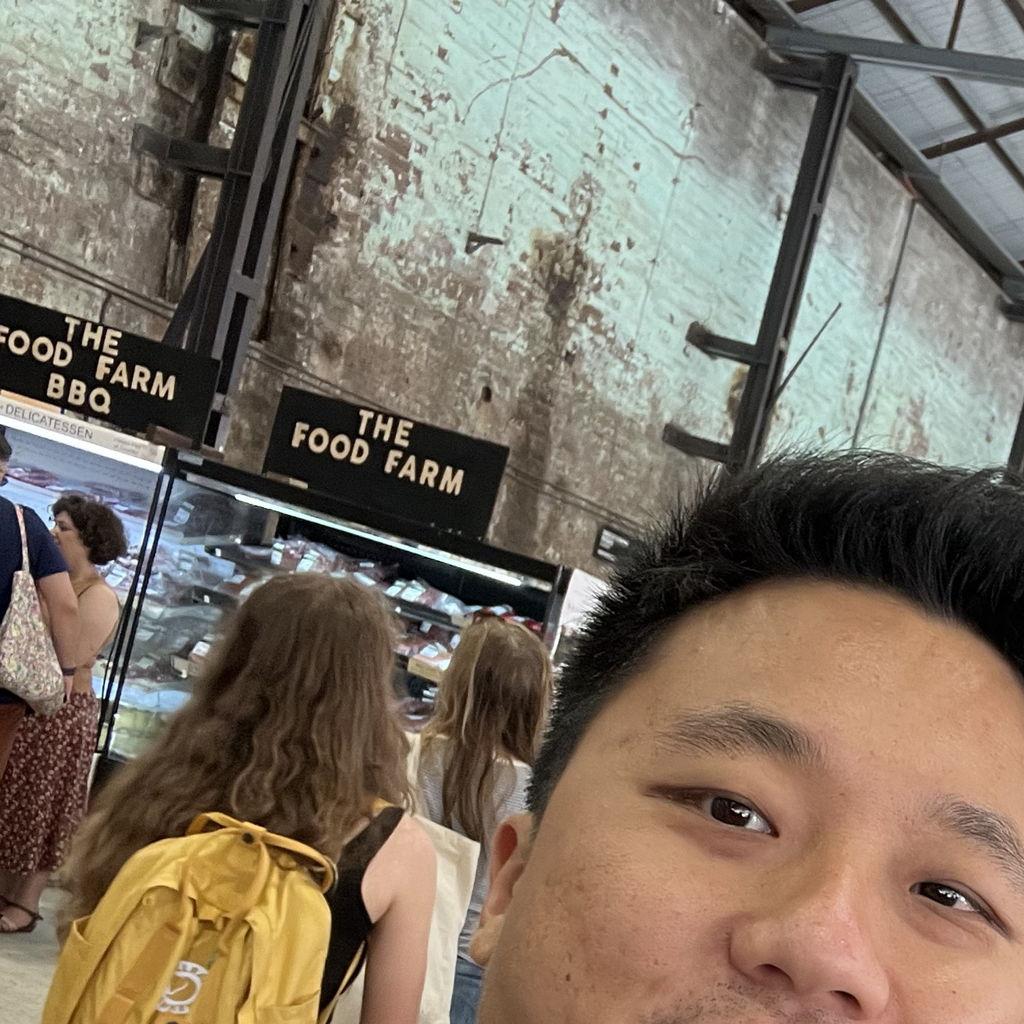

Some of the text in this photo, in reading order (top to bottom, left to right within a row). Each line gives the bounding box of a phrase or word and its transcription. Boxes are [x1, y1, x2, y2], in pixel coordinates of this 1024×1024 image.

[65, 316, 122, 357] THE
[47, 372, 111, 414] BBQ
[95, 355, 176, 400] FARM
[5, 403, 94, 439] DELICATESSEN
[359, 409, 414, 447] THE
[291, 421, 465, 496] FOOD FARM
